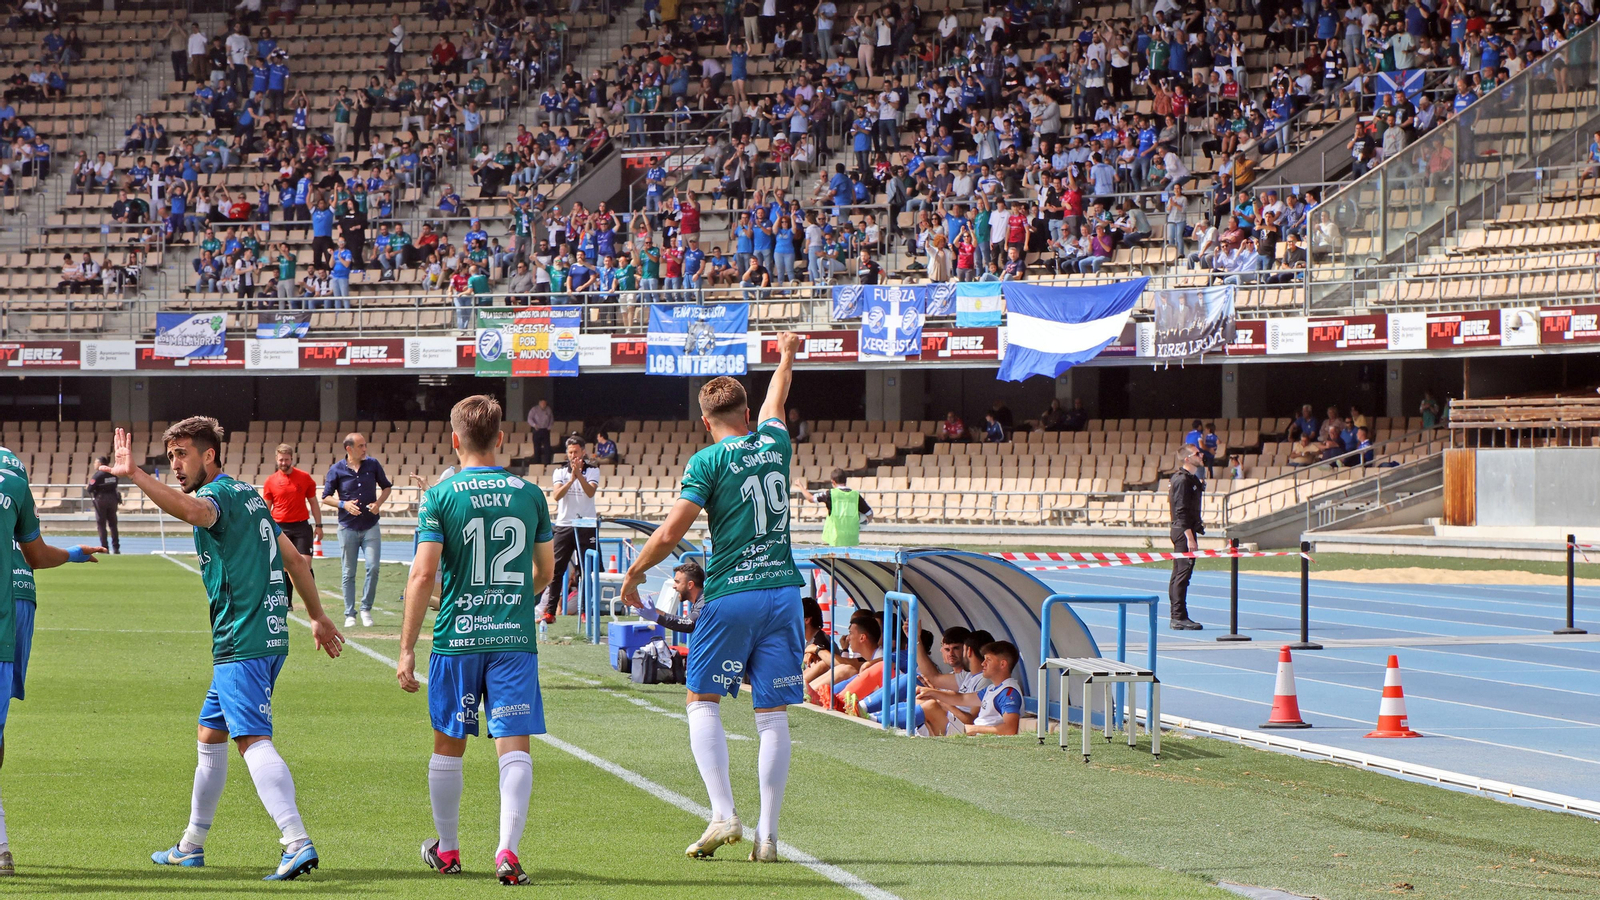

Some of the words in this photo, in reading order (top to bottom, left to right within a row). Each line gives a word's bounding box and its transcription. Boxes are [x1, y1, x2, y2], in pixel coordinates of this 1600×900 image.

[874, 288, 916, 302] FUERZA
[502, 324, 555, 334] XERECISTAS
[1312, 325, 1343, 341] PLAY
[1336, 324, 1377, 348] JEREZ
[1431, 322, 1459, 337] PLAY
[1453, 320, 1490, 344] JEREZ
[1544, 316, 1571, 332] PLAY
[1564, 314, 1598, 340] JEREZ
[519, 336, 536, 346] POR
[795, 339, 843, 359] JEREZ
[863, 337, 919, 352] XERECISTA
[938, 336, 984, 357] JEREZ
[7, 348, 63, 366] JEREZ
[304, 347, 344, 359] PLAY
[335, 346, 388, 365] JEREZ
[507, 350, 517, 359] EL
[520, 350, 552, 359] MUNDO
[649, 354, 675, 373] LOS
[678, 354, 745, 374] INTENSOS
[729, 461, 744, 474] G.
[742, 450, 783, 467] SIMEONE
[452, 478, 506, 493] indeso
[470, 493, 512, 509] RICKY
[739, 470, 788, 538] 19
[259, 518, 284, 584] 2
[462, 516, 526, 586] 12
[727, 573, 754, 584] XEREZ
[755, 570, 794, 580] DEPORTIVO
[474, 615, 493, 623] High
[474, 622, 521, 631] ProNutrition
[449, 638, 476, 647] XEREZ
[478, 636, 528, 645] DEPORTIVO
